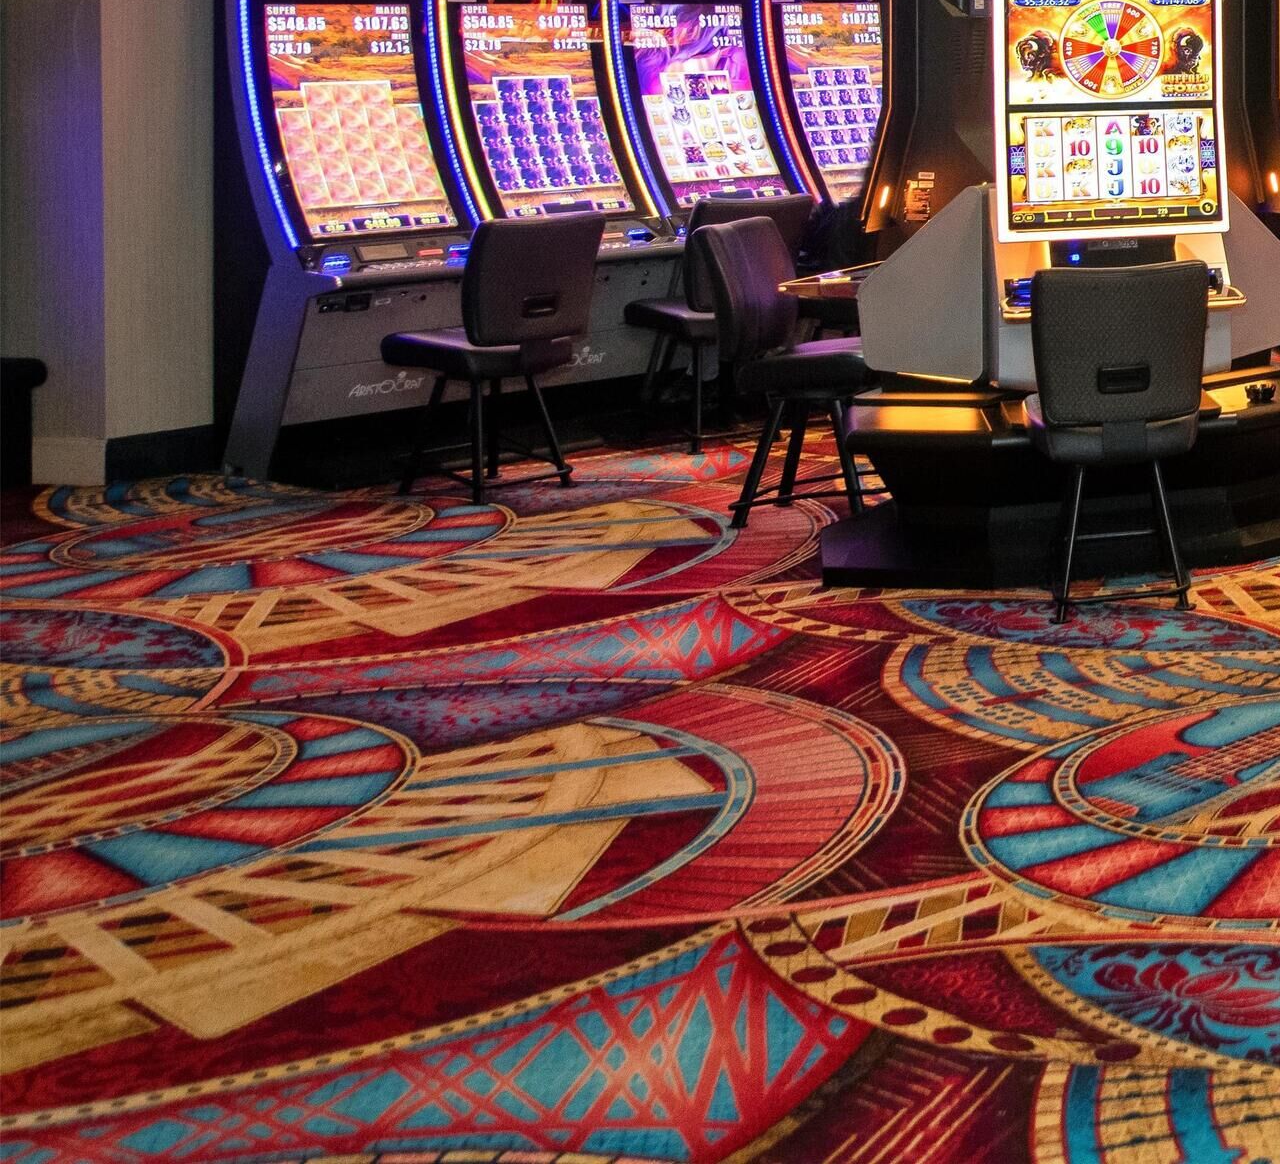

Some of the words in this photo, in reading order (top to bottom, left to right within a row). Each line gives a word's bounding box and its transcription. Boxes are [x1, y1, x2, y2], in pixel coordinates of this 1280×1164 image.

[266, 6, 296, 15] SUPER
[376, 6, 407, 14] MAJOR
[462, 5, 487, 14] SUPER
[557, 5, 585, 14] MAJOR
[715, 5, 740, 13] MAJOR
[1103, 2, 1121, 10] FREE
[354, 16, 408, 31] $107.63
[538, 15, 586, 29] $107.63
